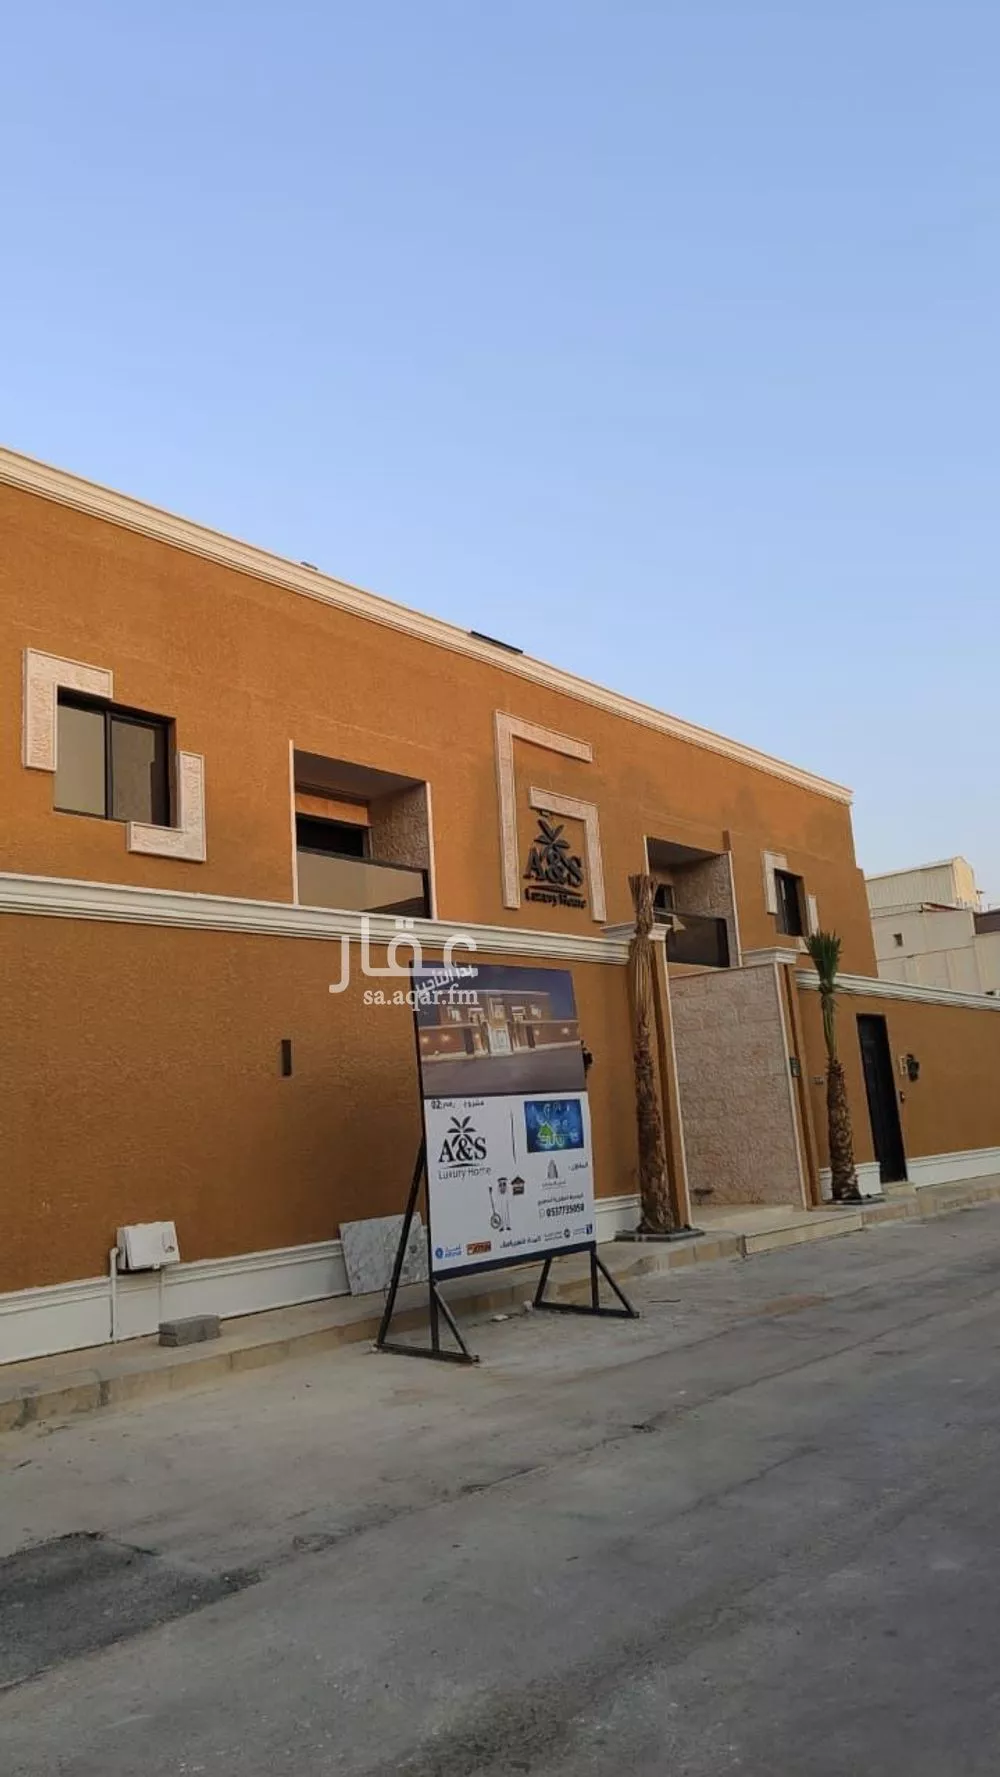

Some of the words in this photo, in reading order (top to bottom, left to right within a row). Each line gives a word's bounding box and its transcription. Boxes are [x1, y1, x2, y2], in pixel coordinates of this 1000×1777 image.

[523, 846, 584, 888] A&S
[438, 1136, 487, 1163] A&S
[438, 1169, 466, 1180] Luxury
[467, 1167, 492, 1177] Home
